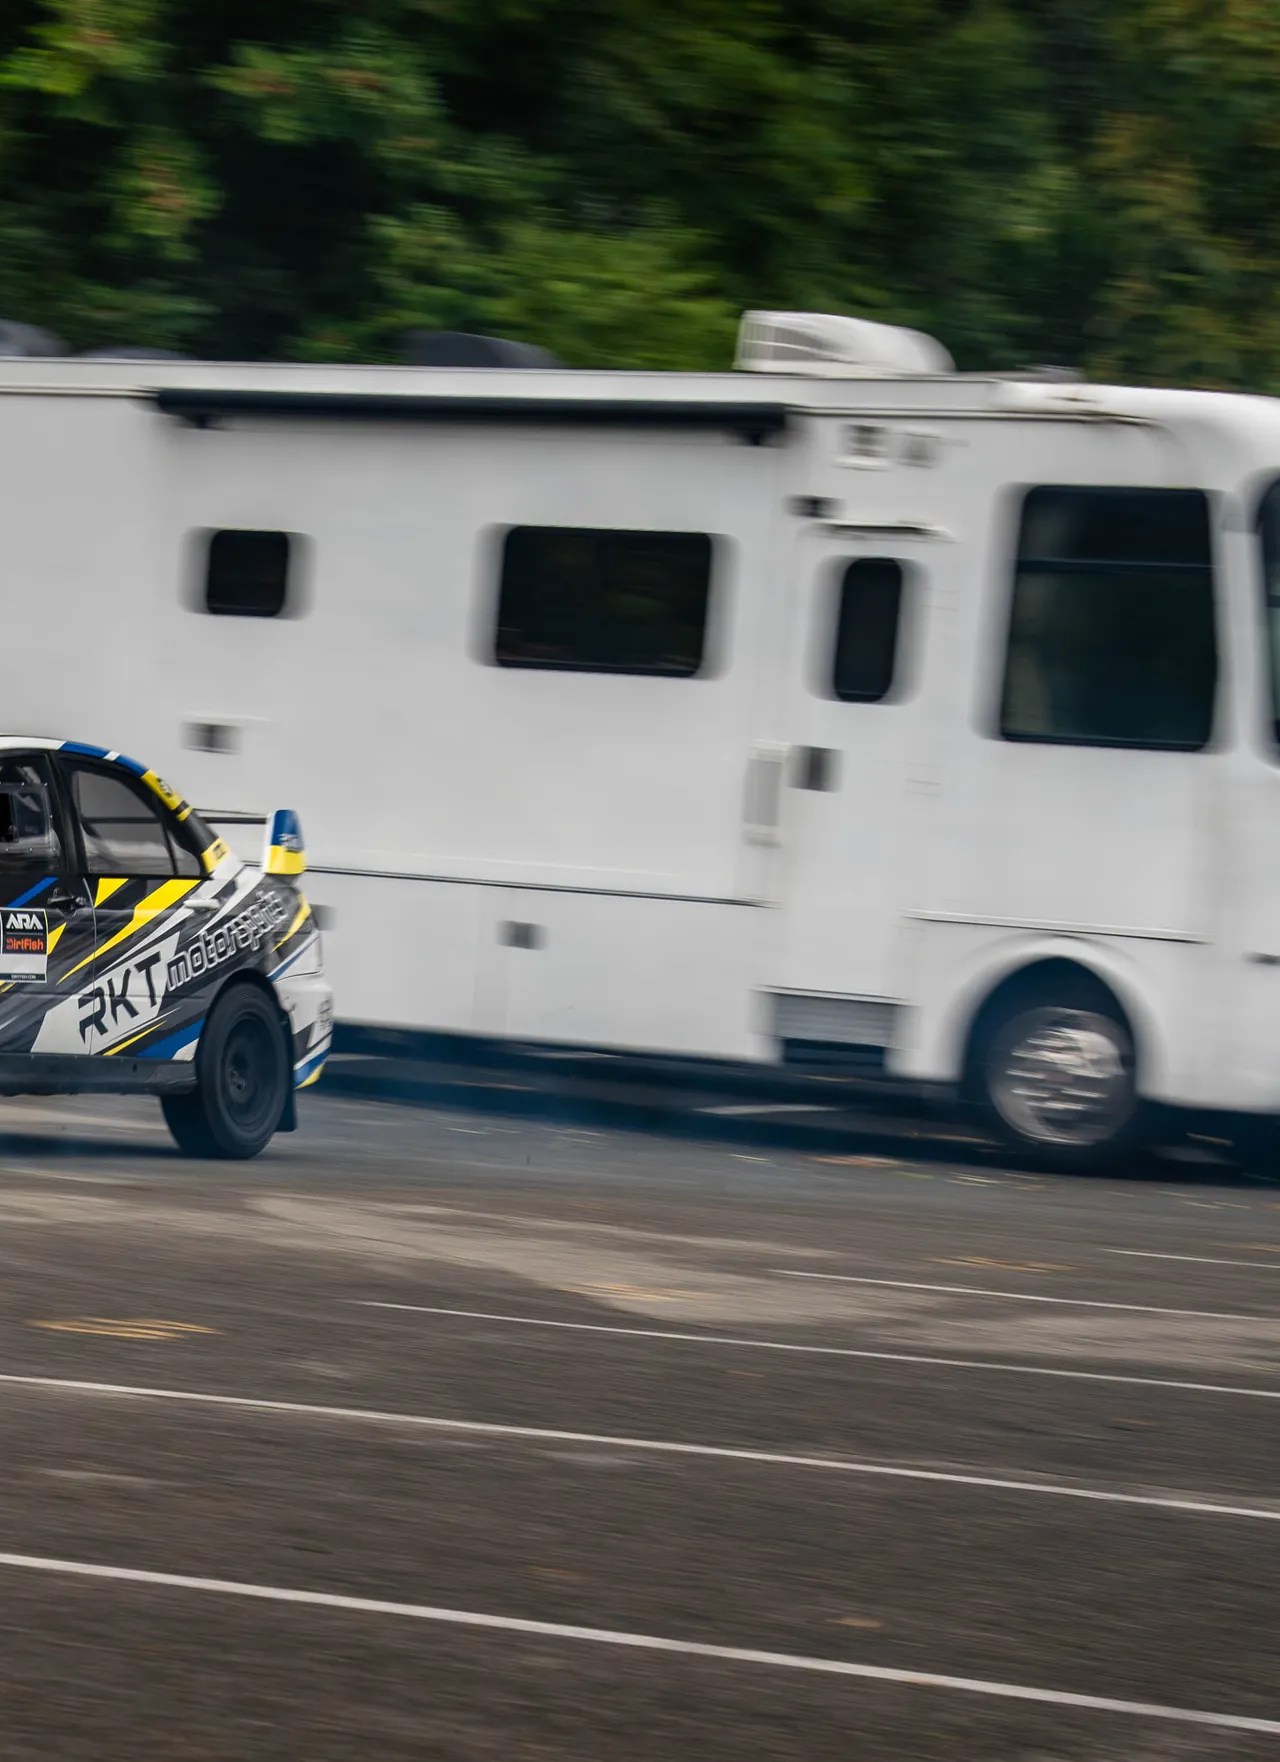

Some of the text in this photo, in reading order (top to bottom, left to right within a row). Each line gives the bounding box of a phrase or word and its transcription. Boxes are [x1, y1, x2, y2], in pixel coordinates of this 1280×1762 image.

[5, 912, 44, 930] ARA
[5, 937, 44, 952] DirtFish
[77, 951, 162, 1044] RKT
